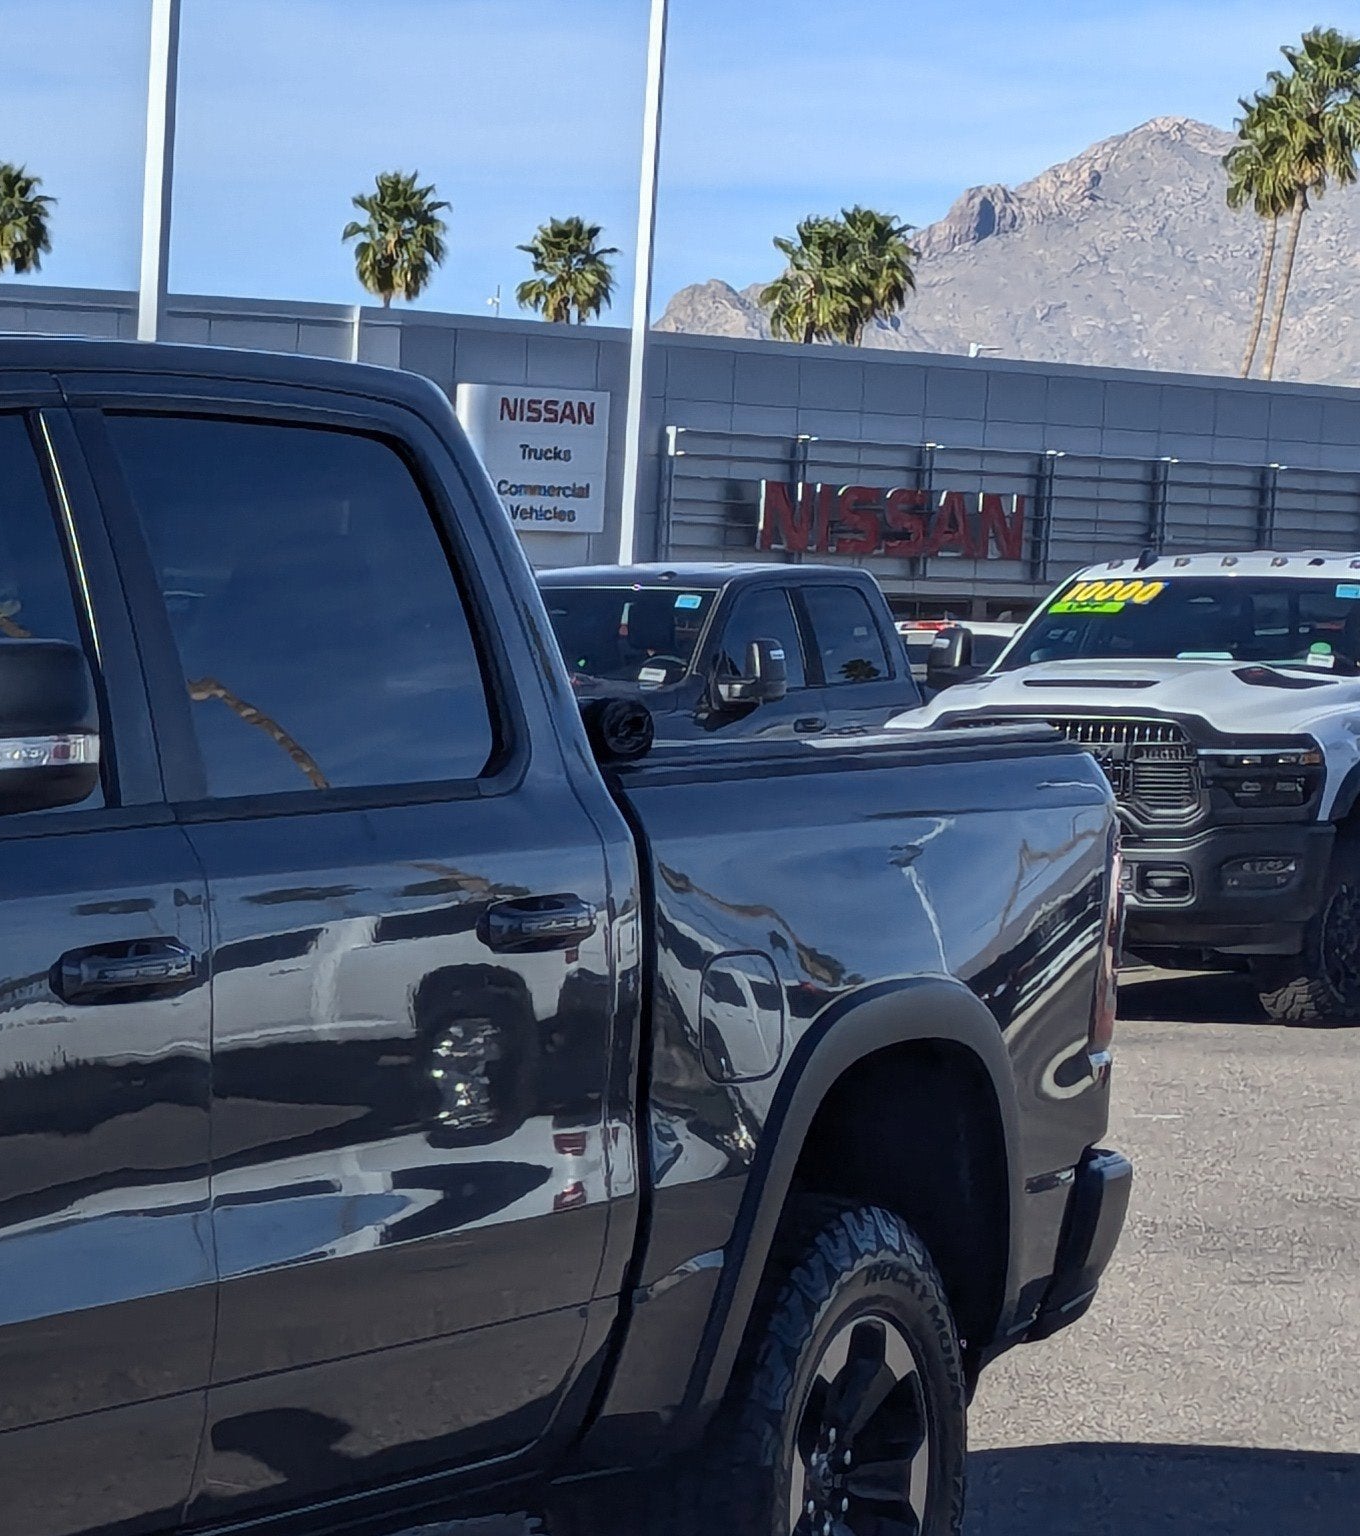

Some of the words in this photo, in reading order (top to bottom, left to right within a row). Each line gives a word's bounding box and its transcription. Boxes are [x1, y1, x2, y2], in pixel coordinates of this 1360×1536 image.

[500, 397, 595, 425] NISSAN
[519, 444, 572, 462] Trucks
[497, 479, 590, 499] Commercial
[509, 504, 576, 522] Vehicles
[757, 479, 1025, 560] NISSAN
